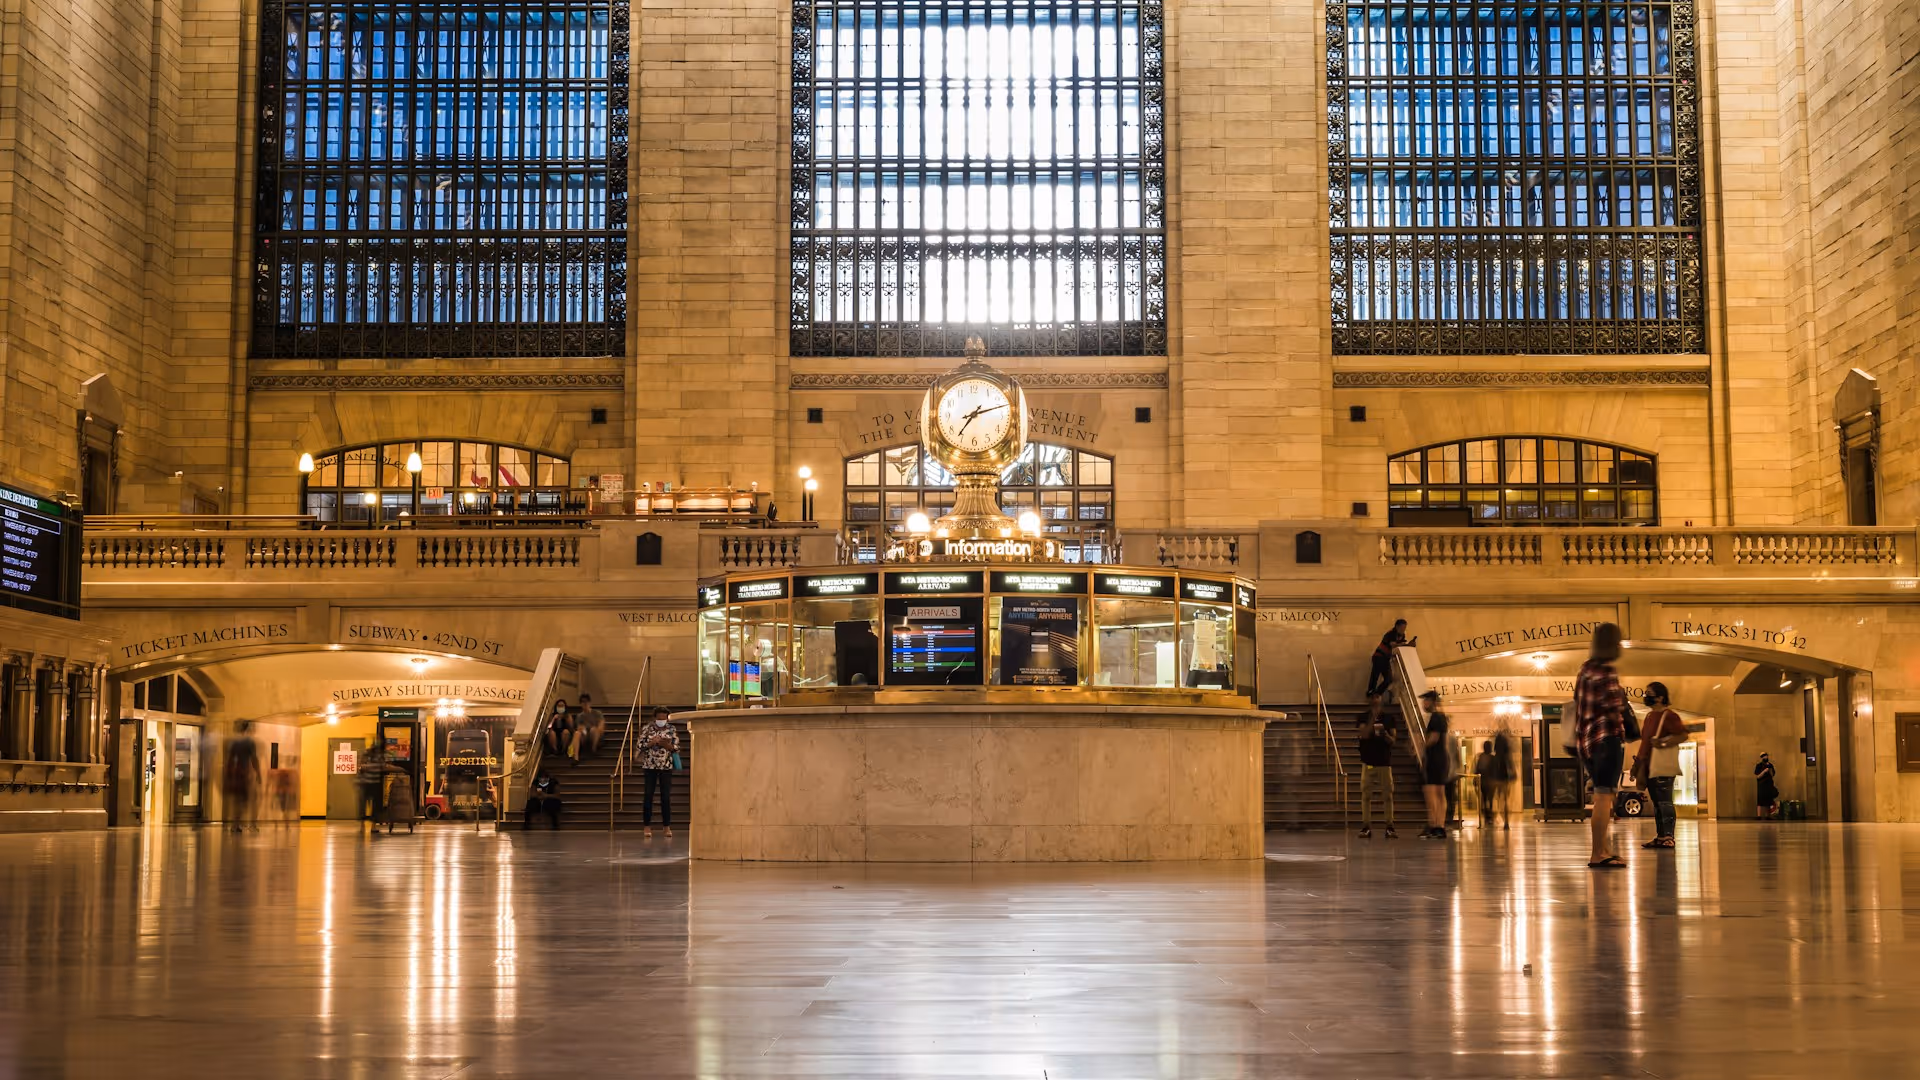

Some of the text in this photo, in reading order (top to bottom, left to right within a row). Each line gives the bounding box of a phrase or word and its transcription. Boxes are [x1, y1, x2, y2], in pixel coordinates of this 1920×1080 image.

[957, 389, 964, 398] 11
[970, 385, 978, 394] 12
[947, 398, 955, 408] 10
[872, 413, 894, 426] TO
[945, 412, 951, 421] 9
[1030, 408, 1086, 426] VENUE
[949, 425, 955, 435] 8
[994, 424, 1000, 434] 4
[1030, 422, 1098, 444] RTMENT
[860, 428, 894, 444] THE
[984, 433, 991, 444] 5
[971, 436, 978, 447] 6
[316, 453, 368, 471] CIPRANI
[945, 539, 1031, 556] Information
[808, 578, 865, 587] MTA METRO-NORTH
[917, 576, 967, 584] METRO-NORTH
[1005, 576, 1072, 584] MTA METRO-NORTH
[1119, 578, 1161, 587] METRO-NORTH
[751, 589, 782, 598] INFORMATION
[618, 612, 698, 623] WEST BALCO
[911, 608, 958, 617] ARRIVALS
[1038, 612, 1073, 620] ANYWHERE
[1256, 611, 1341, 622] EST BALCONY
[121, 623, 288, 658] TICKET MACHINES
[349, 624, 504, 656] SUBWAY 42ND ST
[1455, 622, 1600, 653] TICKET MACHIN
[1671, 621, 1807, 650] TRACKS 31 TO 42
[1452, 680, 1513, 695] PASSAGE
[333, 685, 526, 702] SUBWAY SHUTTLE PASSAGE
[338, 754, 353, 762] FIRE
[440, 757, 497, 766] FLUSHING
[335, 763, 355, 772] HOSE
